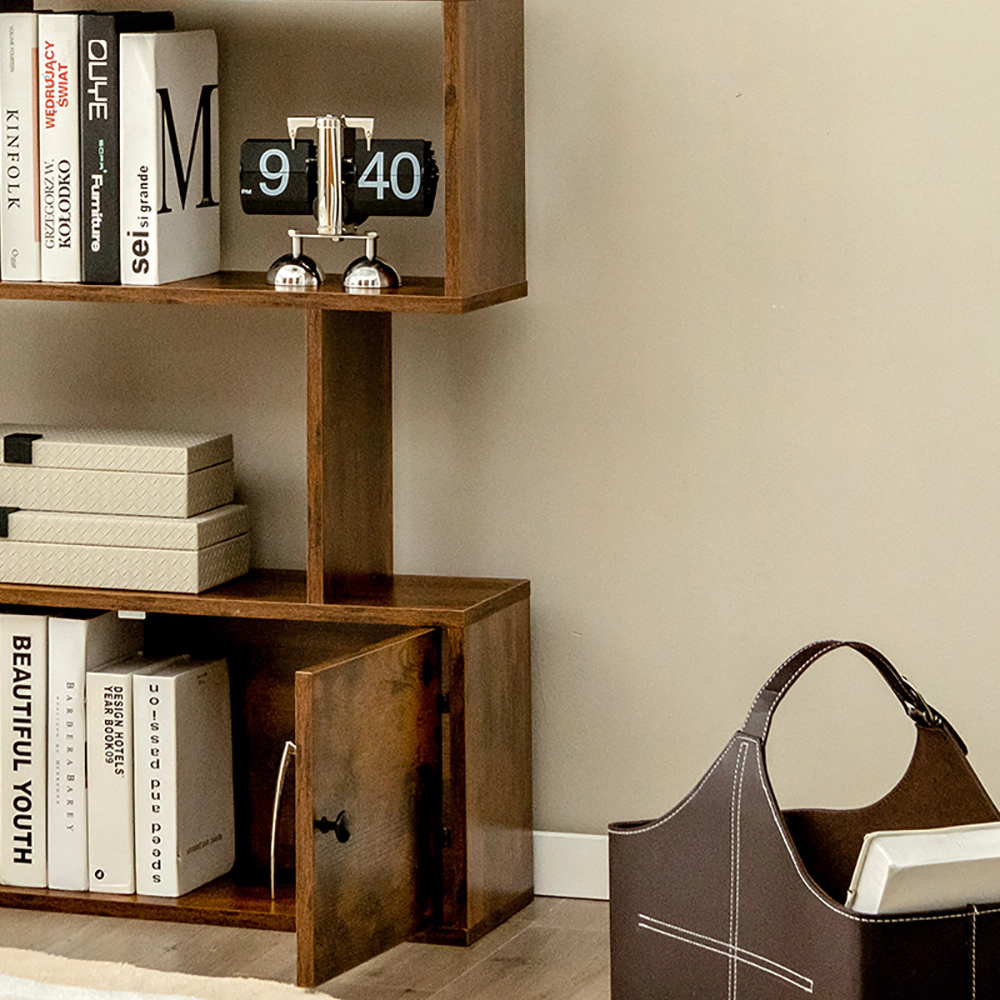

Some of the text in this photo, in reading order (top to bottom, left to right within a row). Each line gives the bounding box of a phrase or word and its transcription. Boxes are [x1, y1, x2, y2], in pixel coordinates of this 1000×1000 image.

[44, 40, 57, 129] WĘDRUJĄCY
[57, 63, 69, 107] ŚWIAT
[7, 110, 20, 209] KINFOLK
[156, 84, 220, 214] M
[260, 149, 420, 199] 9 40
[44, 176, 55, 250] GRZEGORZ
[59, 160, 70, 248] KOŁODKO
[91, 175, 103, 252] Furniture
[127, 165, 151, 274] sei si grande
[104, 686, 113, 714] YEAR
[114, 687, 123, 727] DESIGN
[13, 636, 32, 864] BEAUTIFUL YOUTH
